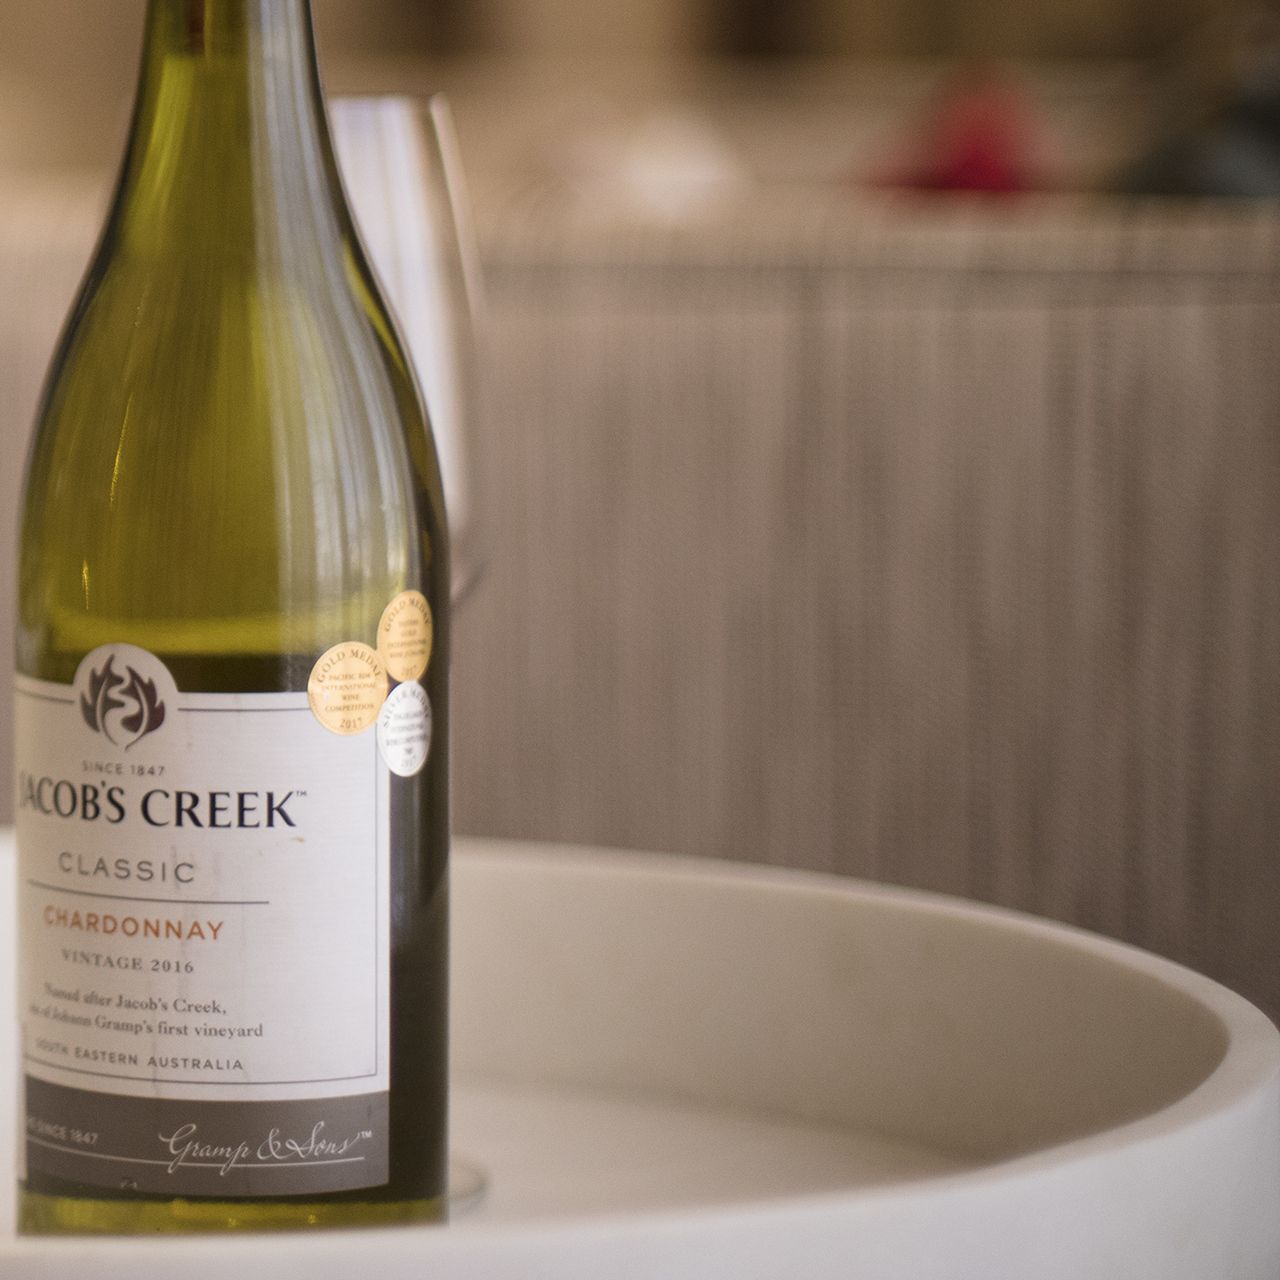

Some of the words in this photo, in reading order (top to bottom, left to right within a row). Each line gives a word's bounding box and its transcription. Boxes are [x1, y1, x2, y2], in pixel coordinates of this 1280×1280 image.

[317, 651, 346, 683] GOLD
[350, 648, 381, 677] MEDAL
[340, 717, 362, 729] 2017
[82, 760, 123, 775] SINCE
[131, 764, 165, 777] 1847
[58, 852, 195, 884] CLASSIC
[42, 905, 224, 941] CHARDONNAY
[60, 948, 143, 970] VINTAGE
[150, 959, 195, 973] 2016
[115, 994, 169, 1012] Jacob's
[172, 998, 228, 1016] Creek,
[94, 1015, 153, 1036] Gramp's
[157, 1021, 189, 1037] first
[193, 1024, 264, 1040] vineyard
[75, 1047, 138, 1066] EASTERN
[148, 1056, 244, 1071] AUSTRALIA
[158, 1123, 252, 1176] Gramp
